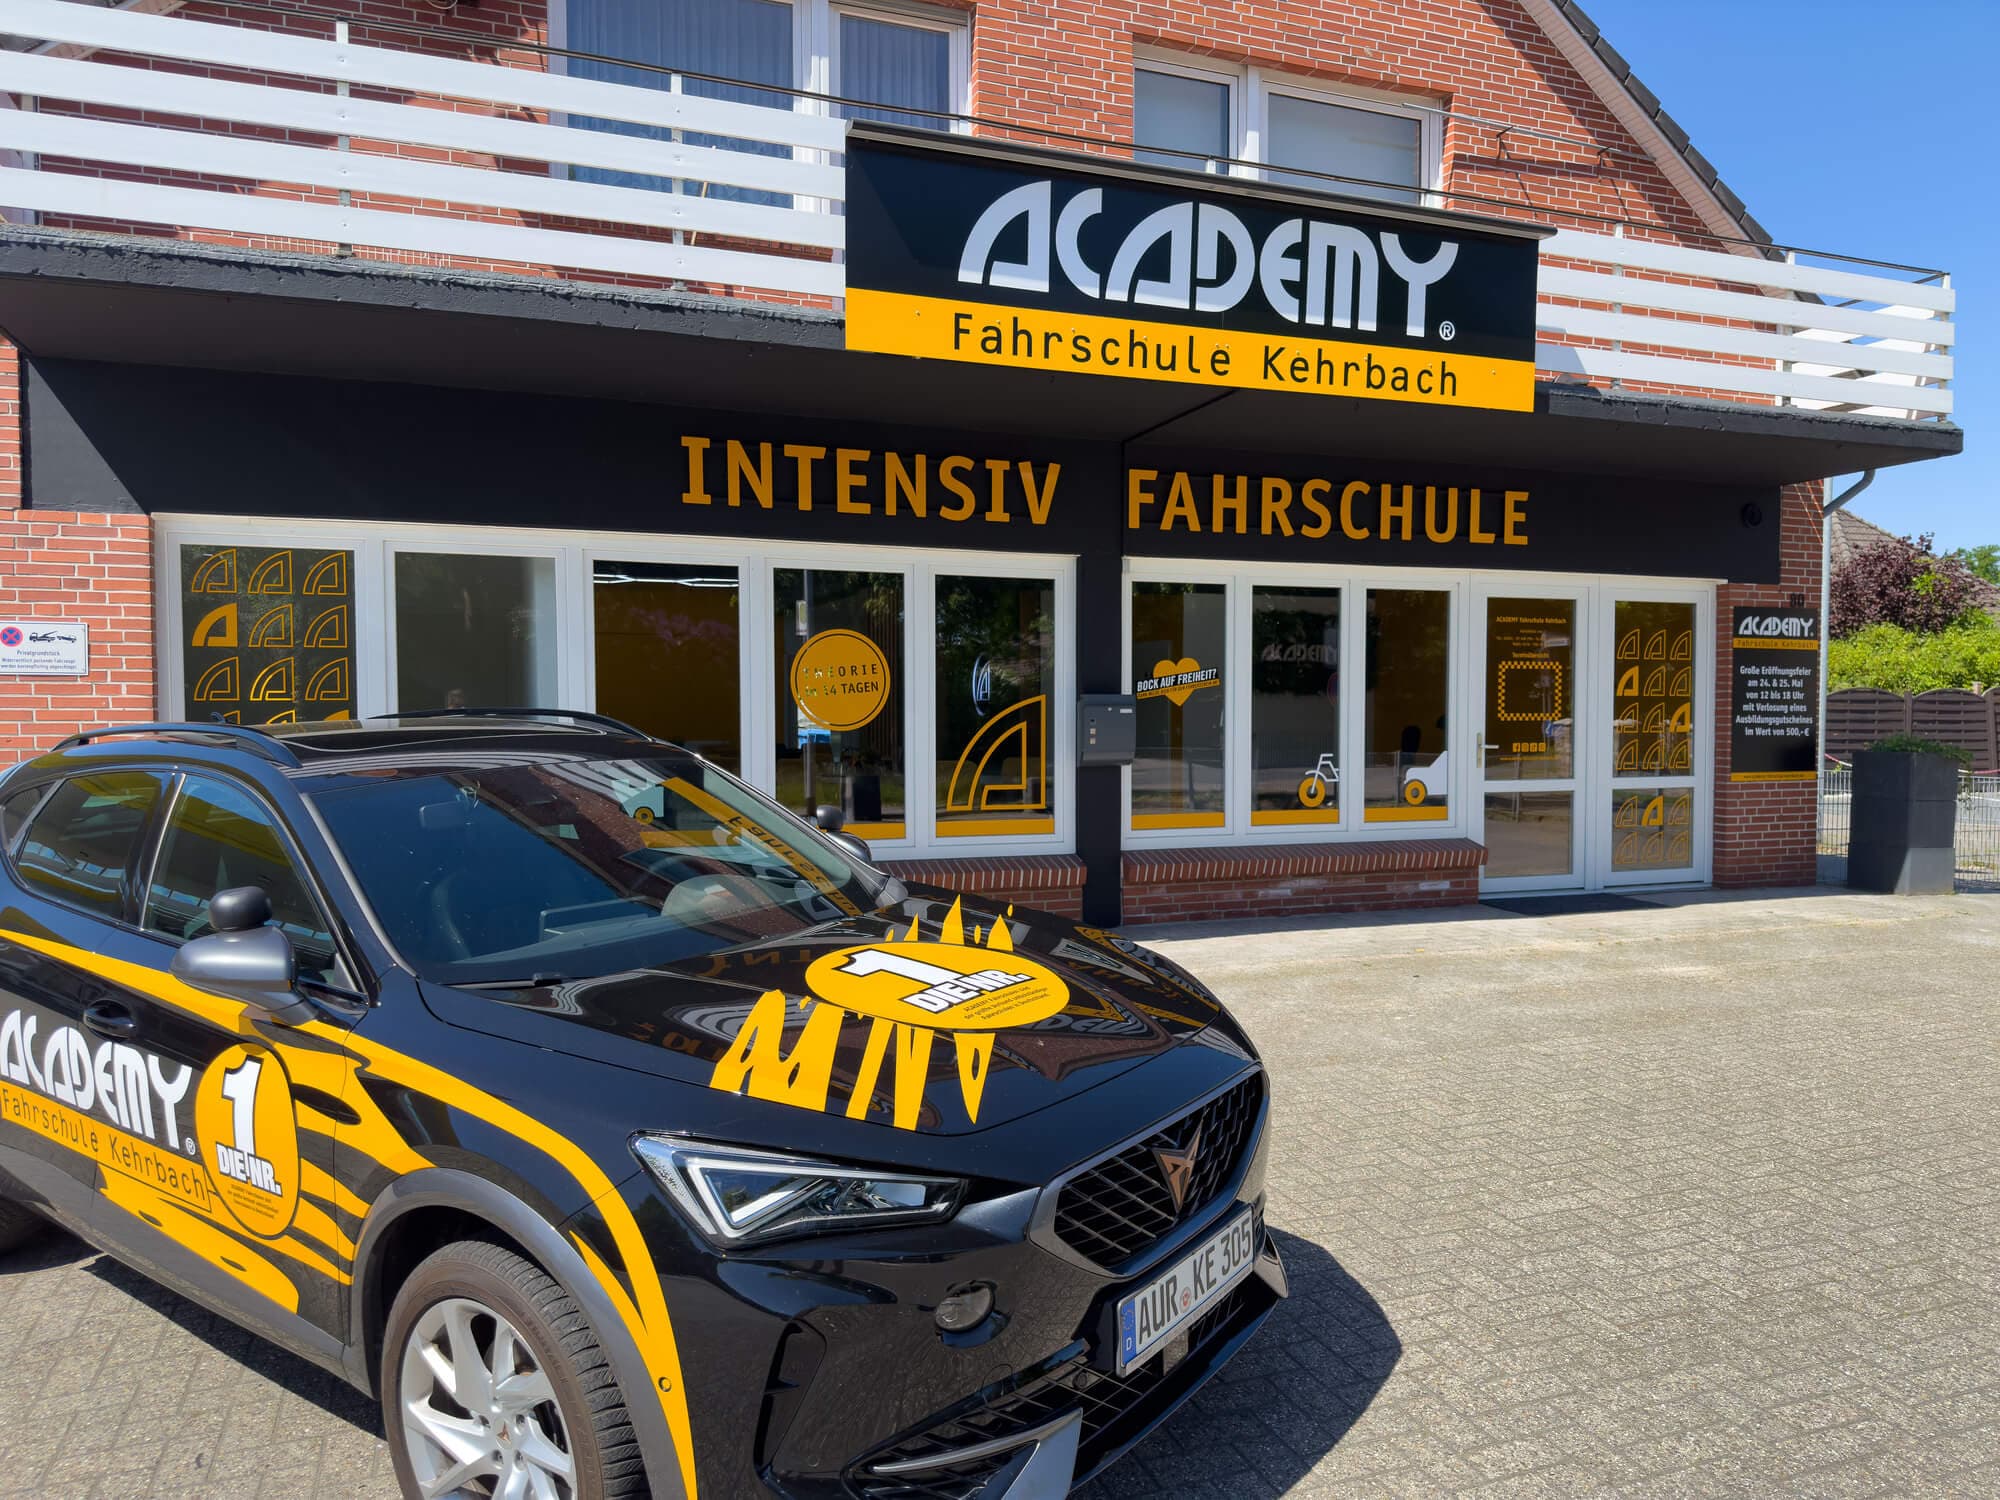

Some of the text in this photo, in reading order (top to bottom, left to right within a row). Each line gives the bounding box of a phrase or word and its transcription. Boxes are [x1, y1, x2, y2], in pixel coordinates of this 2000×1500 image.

[958, 180, 1459, 338] ACADEMY
[953, 312, 1458, 397] Fahrschule Kehrbach
[681, 436, 1529, 545] INTENSIV FAHRSCHULE
[1739, 616, 1813, 637] ACADEMY
[1137, 679, 1159, 692] BOCK
[1160, 676, 1176, 688] AUF
[1177, 668, 1217, 685] FREIHEIT?
[1740, 666, 1812, 677] Große Eröffnungsfeier
[841, 681, 879, 694] TAGEN
[1760, 679, 1771, 687] 24.
[1779, 679, 1790, 687] 25.
[1760, 691, 1769, 699] 12
[1770, 691, 1781, 699] bis
[1792, 691, 1804, 699] Uhr
[1743, 703, 1807, 713] mit Verlosung eines
[1755, 728, 1771, 736] Wert
[0, 1009, 192, 1150] ACADEMY
[2, 1088, 99, 1153] Fahrschule
[109, 1133, 205, 1201] Kehrbach
[1138, 1217, 1251, 1345] AUR KE 305
